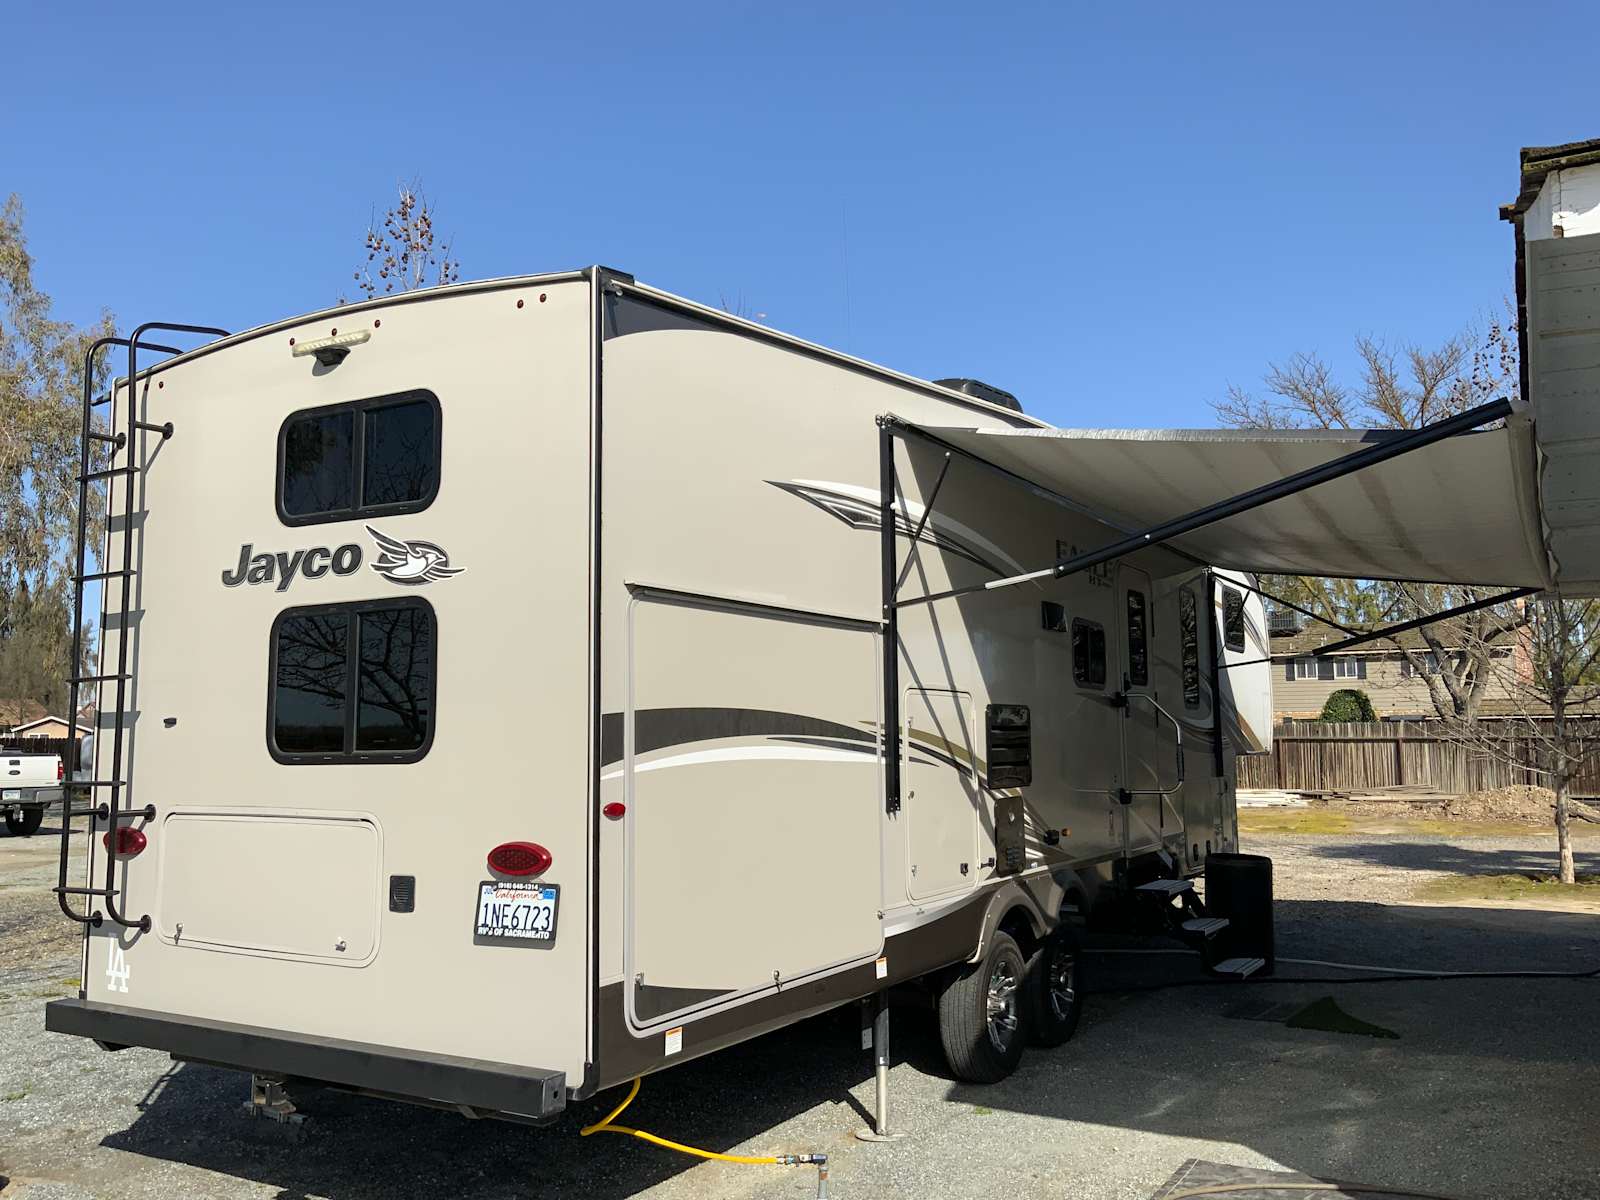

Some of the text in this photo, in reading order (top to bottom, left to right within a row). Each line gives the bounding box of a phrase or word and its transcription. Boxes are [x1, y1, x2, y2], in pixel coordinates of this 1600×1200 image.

[222, 543, 363, 593] Jayco
[495, 889, 538, 902] California
[481, 902, 551, 931] 1NE6723
[493, 928, 504, 936] OF
[105, 933, 131, 993] LA
